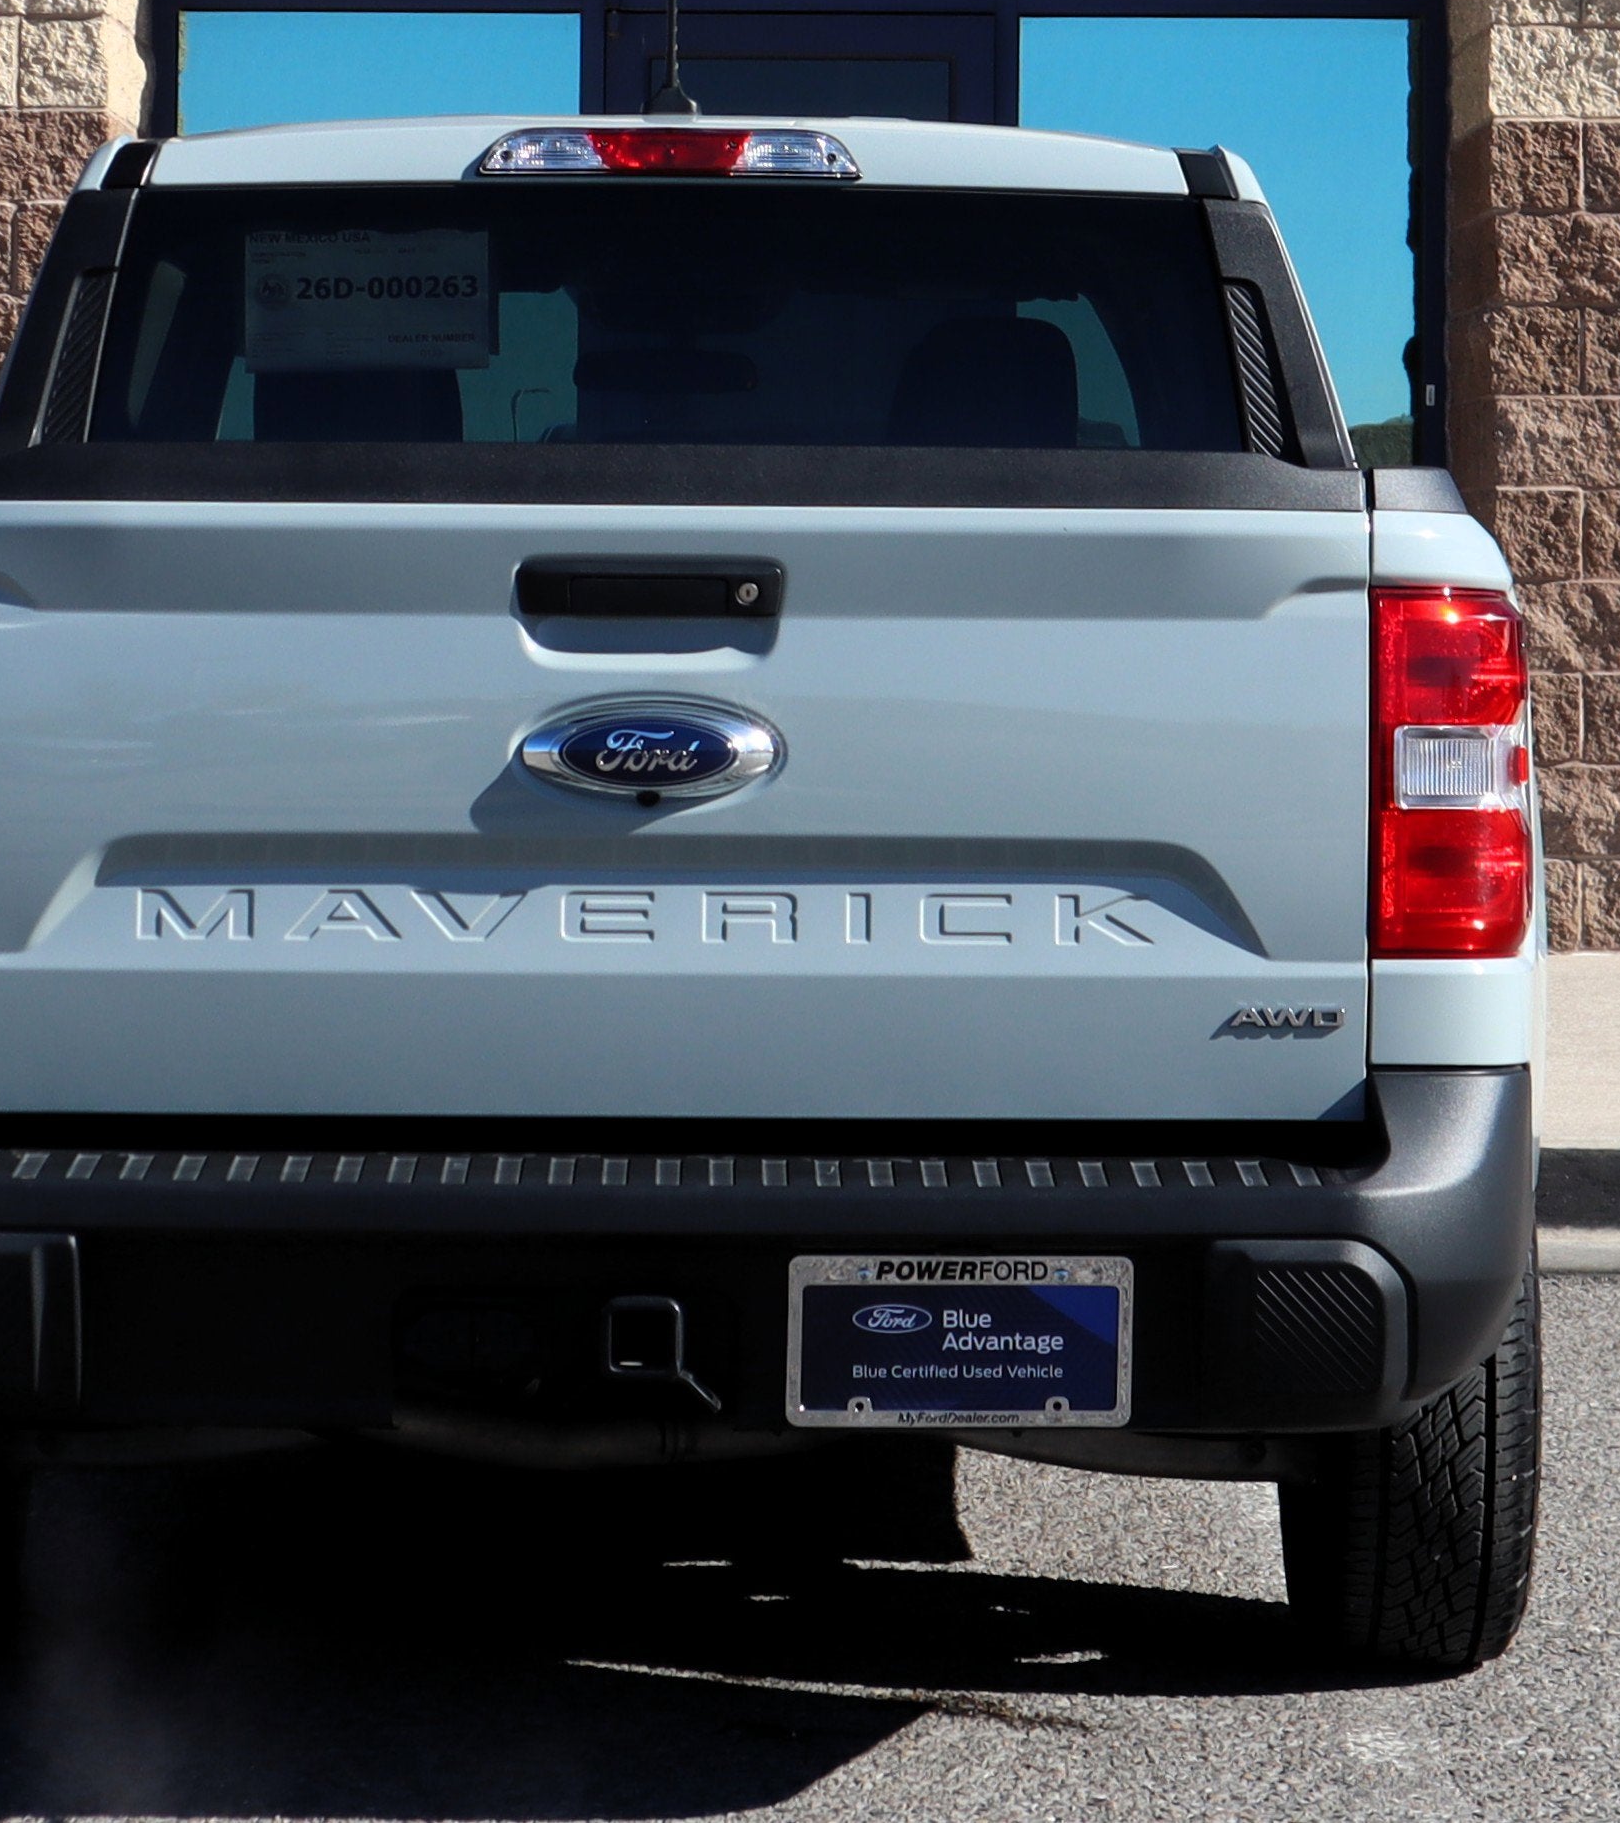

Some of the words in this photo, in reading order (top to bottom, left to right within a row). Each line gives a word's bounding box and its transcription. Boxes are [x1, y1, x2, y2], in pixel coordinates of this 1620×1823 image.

[295, 274, 479, 300] 26D-000263
[387, 333, 428, 343] DEALER
[431, 332, 475, 343] NUMBER
[595, 728, 702, 773] Ford
[135, 887, 1156, 945] MAVERICK
[1229, 1006, 1346, 1028] AWD
[875, 1260, 1048, 1281] POWERFORD
[867, 1307, 917, 1329] Ford
[942, 1309, 992, 1329] Blue
[941, 1332, 1064, 1355] Advantage
[852, 1364, 887, 1379] Blue
[891, 1364, 958, 1379] Certified
[962, 1364, 1003, 1379] Used
[1007, 1364, 1064, 1379] Vehicle
[897, 1411, 1020, 1427] MyFordDealer.com
